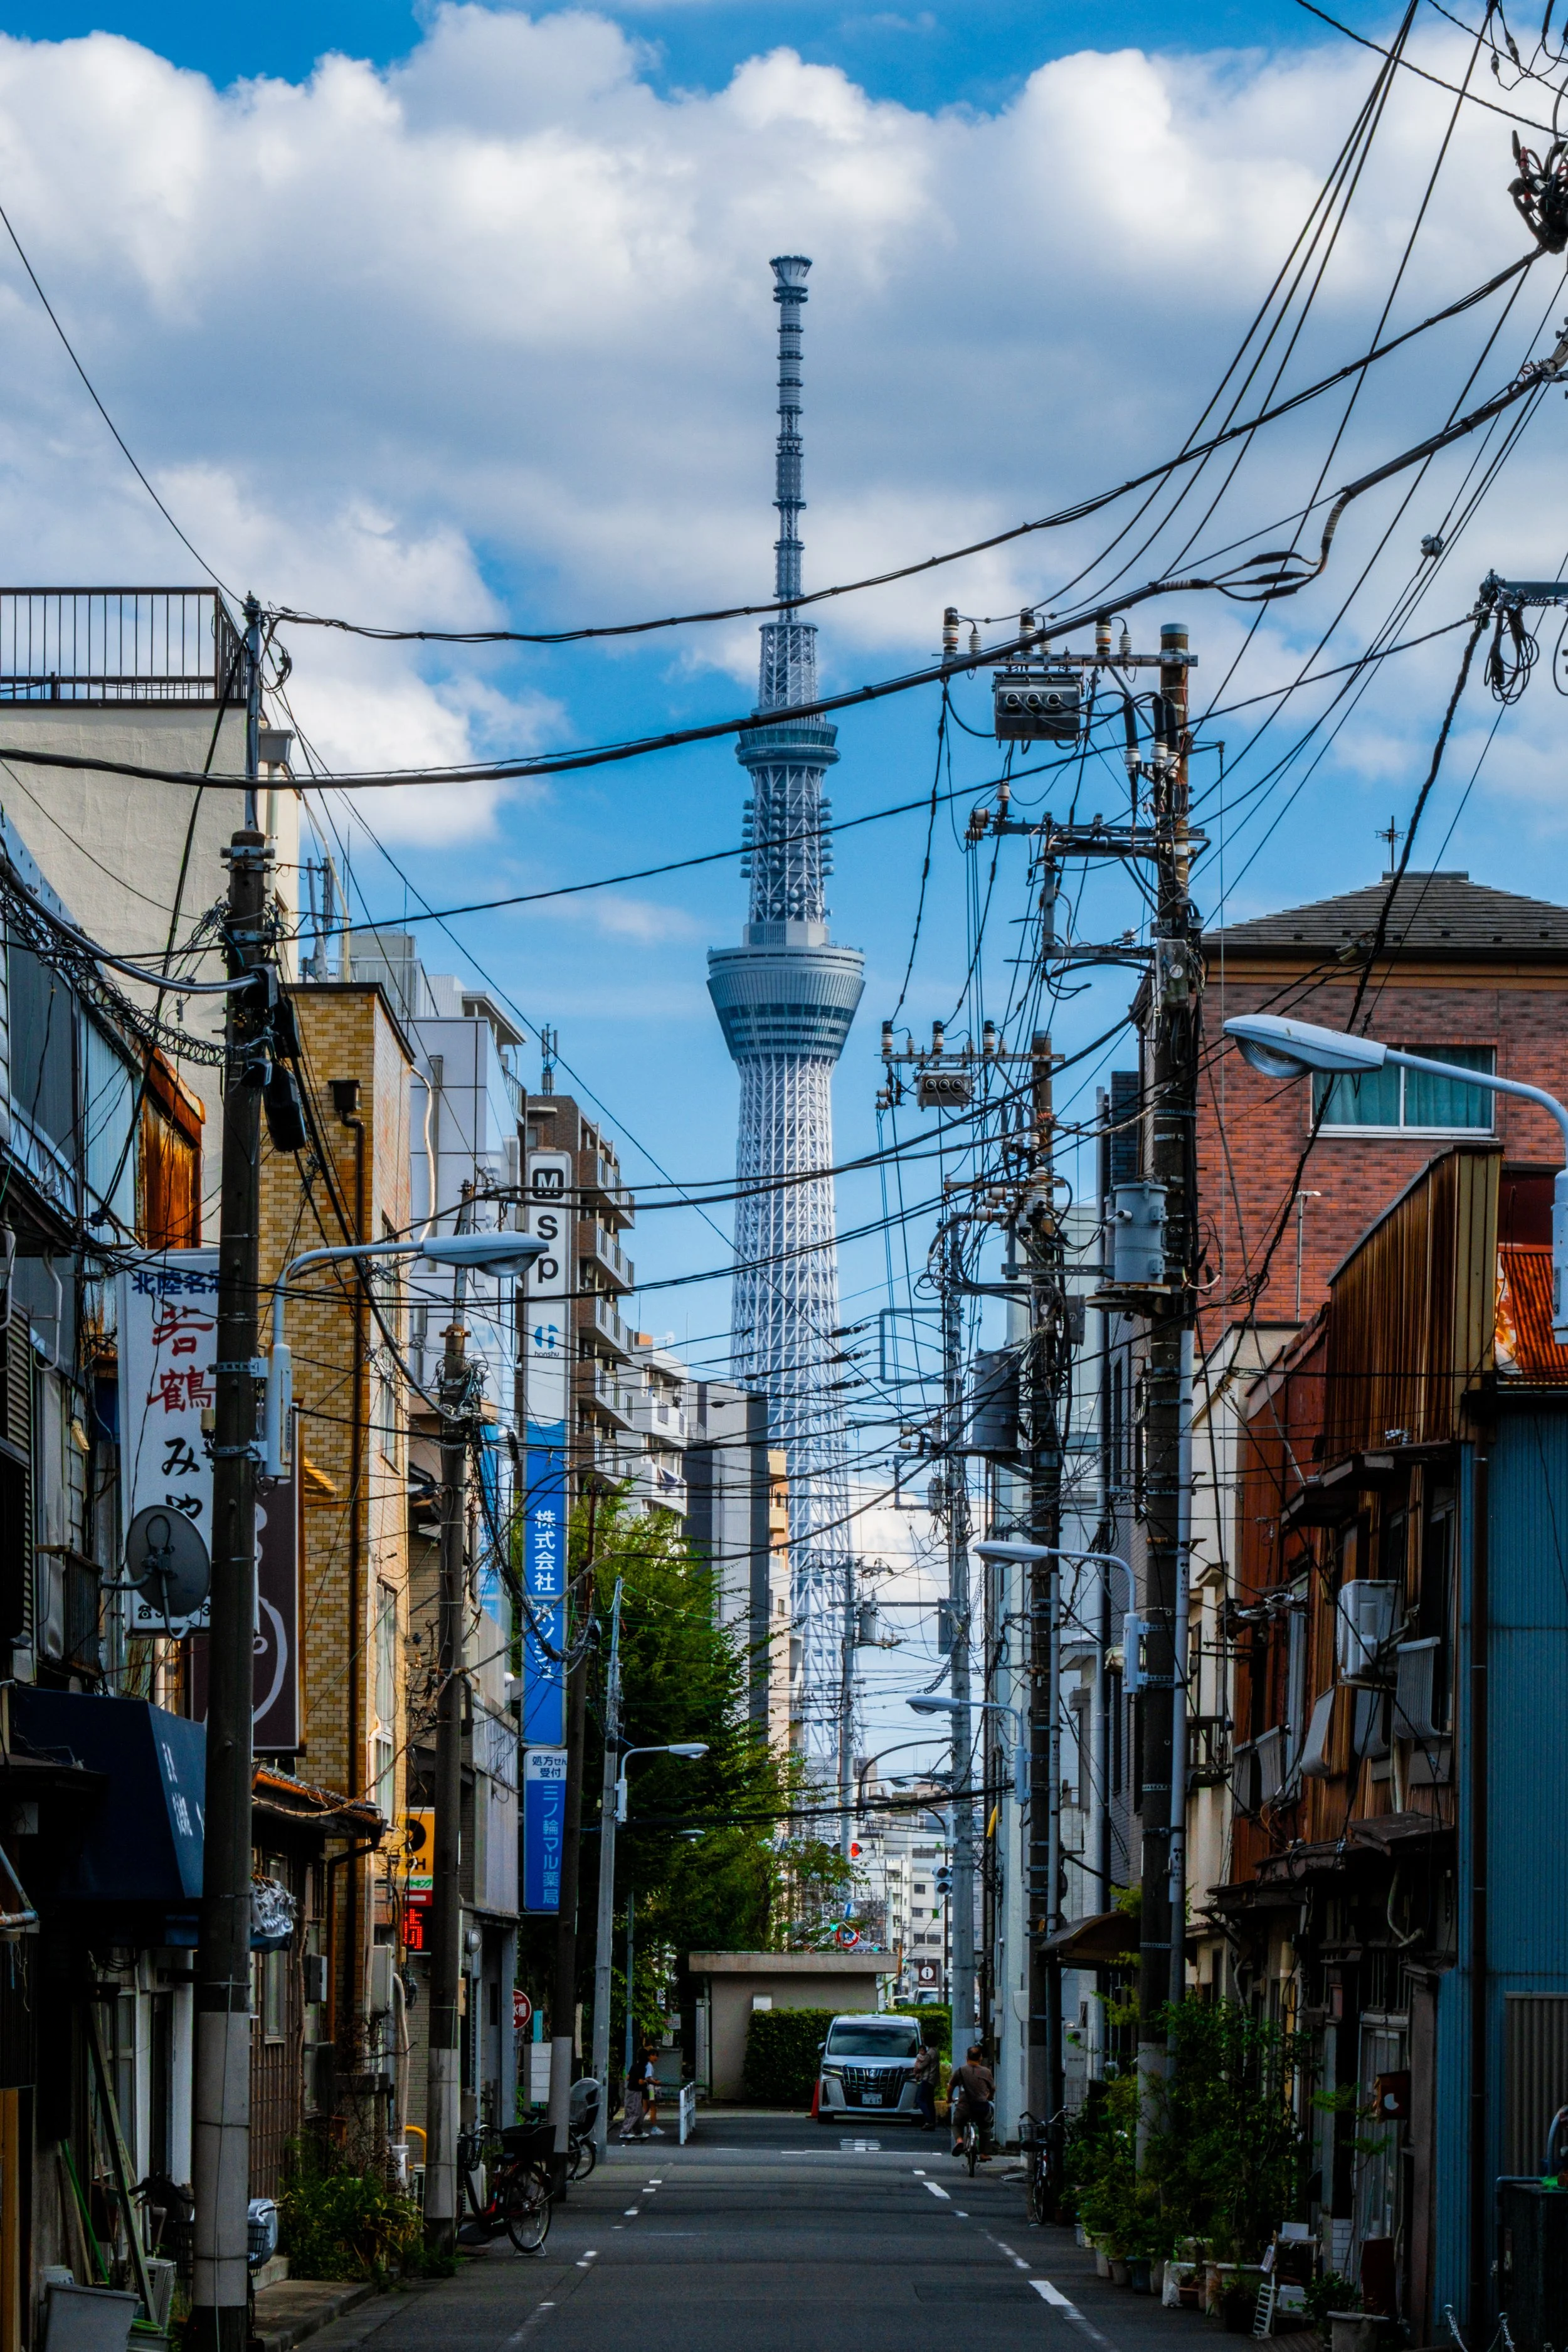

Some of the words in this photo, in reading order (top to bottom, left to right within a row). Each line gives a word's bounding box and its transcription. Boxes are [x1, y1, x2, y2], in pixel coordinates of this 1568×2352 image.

[146, 1304, 218, 1414] 若鶴
[532, 1756, 568, 1766] 処方せん
[539, 1767, 561, 1778] 受付
[543, 1785, 559, 1905] 三ノ輪マル薬局
